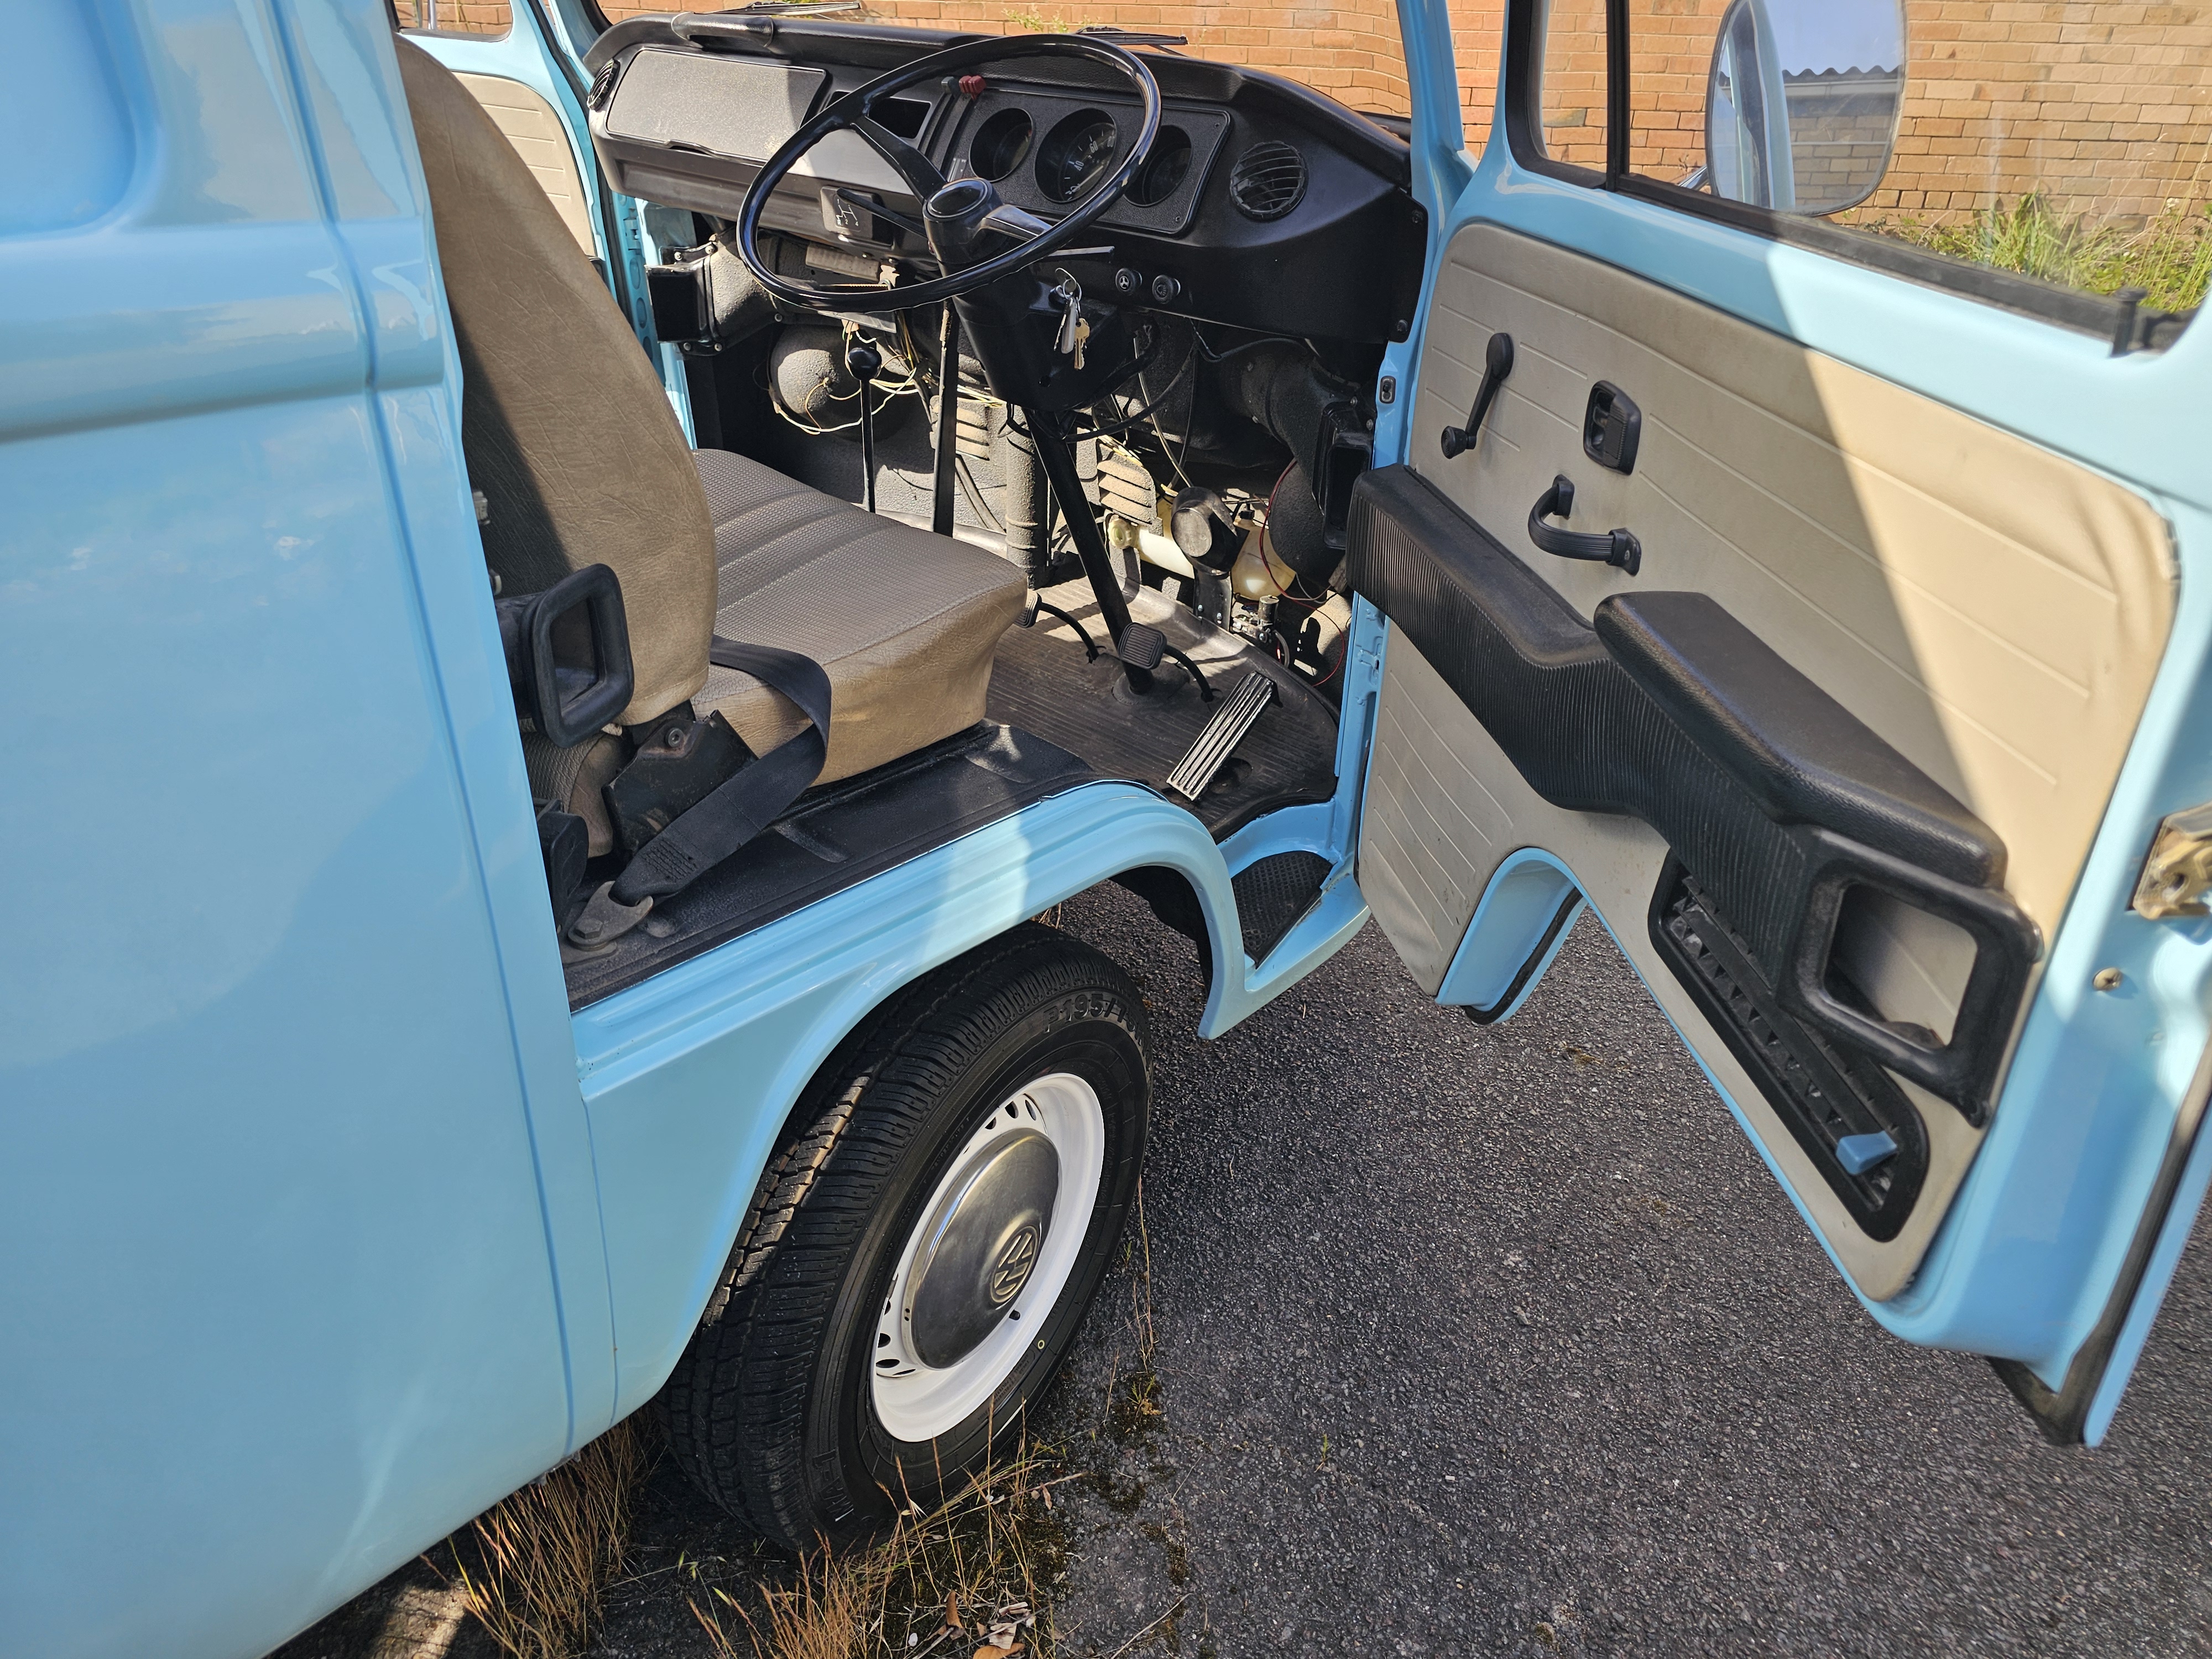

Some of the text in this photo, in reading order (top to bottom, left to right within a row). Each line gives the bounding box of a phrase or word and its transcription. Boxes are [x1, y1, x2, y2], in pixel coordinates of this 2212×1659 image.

[1089, 140, 1099, 153] 60
[1074, 160, 1084, 171] 40
[991, 1226, 1037, 1302] VW
